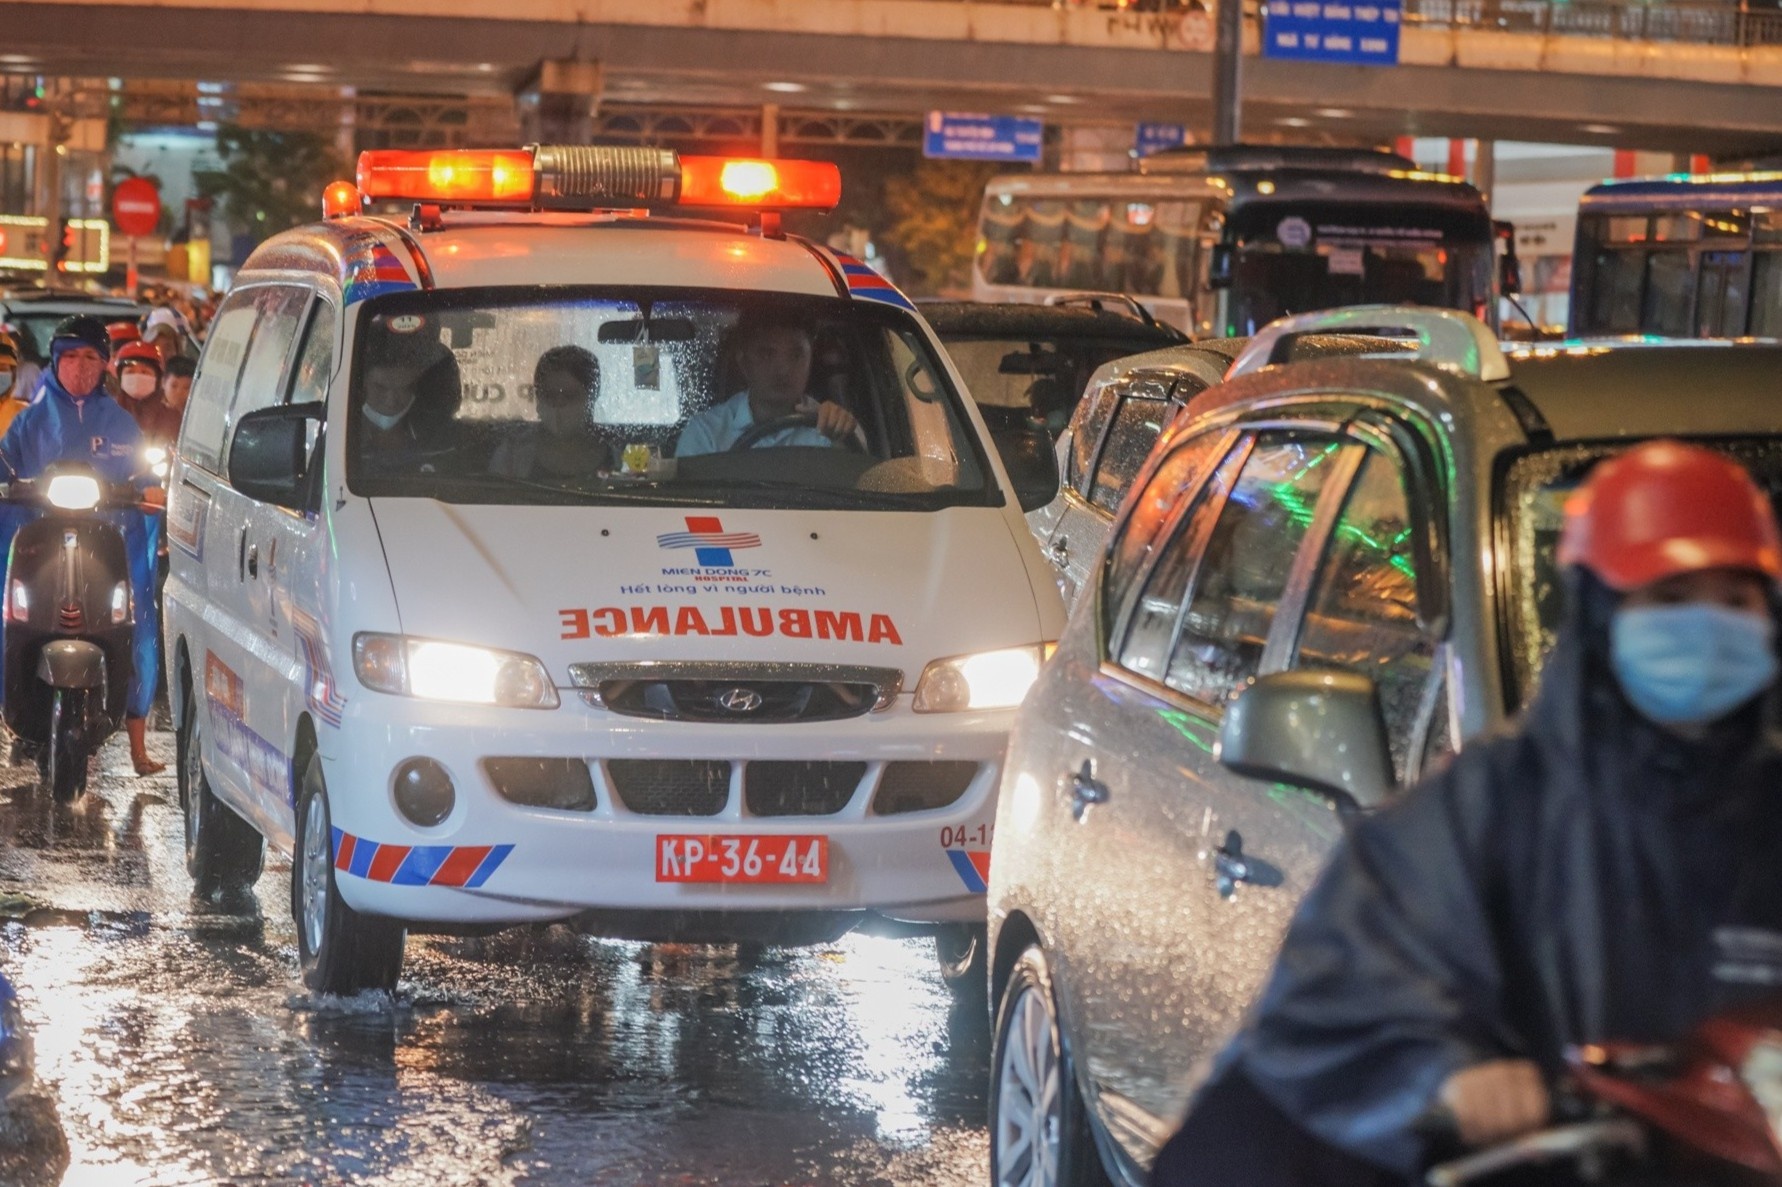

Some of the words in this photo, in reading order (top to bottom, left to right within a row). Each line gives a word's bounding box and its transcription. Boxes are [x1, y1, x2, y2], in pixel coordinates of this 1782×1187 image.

[694, 575, 749, 583] HOSPITAL
[752, 569, 772, 578] 7C
[620, 583, 651, 595] Hết
[657, 583, 697, 595] lòng
[703, 583, 719, 593] vì
[724, 582, 776, 596] người
[780, 583, 826, 597] bệnh
[940, 823, 995, 849] 04-1
[661, 838, 821, 878] KP-36-44
